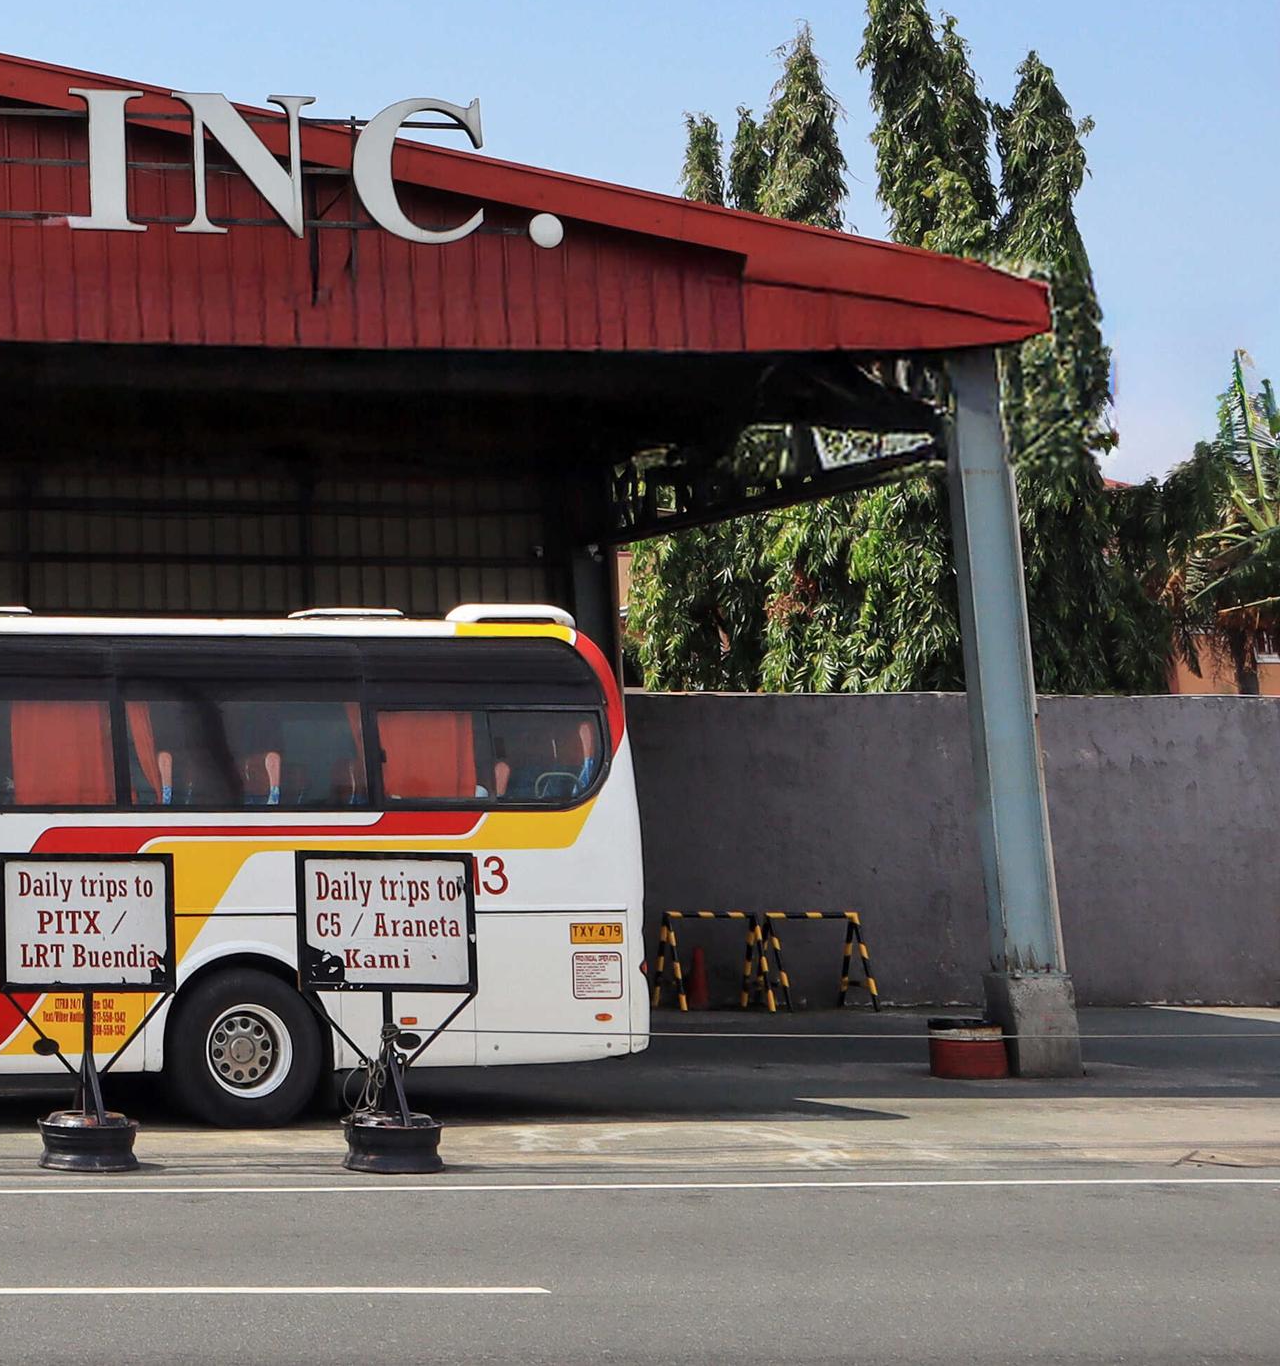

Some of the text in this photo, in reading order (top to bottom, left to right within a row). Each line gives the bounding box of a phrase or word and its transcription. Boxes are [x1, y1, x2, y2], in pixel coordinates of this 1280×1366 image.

[68, 87, 564, 248] INC.
[18, 871, 154, 903] Daily trips to
[315, 871, 458, 907] Daily trips to
[37, 910, 102, 935] PITX
[316, 912, 341, 938] C5
[374, 912, 461, 938] Araneta
[572, 925, 621, 937] TXY 479
[20, 943, 159, 968] LRT Buendia
